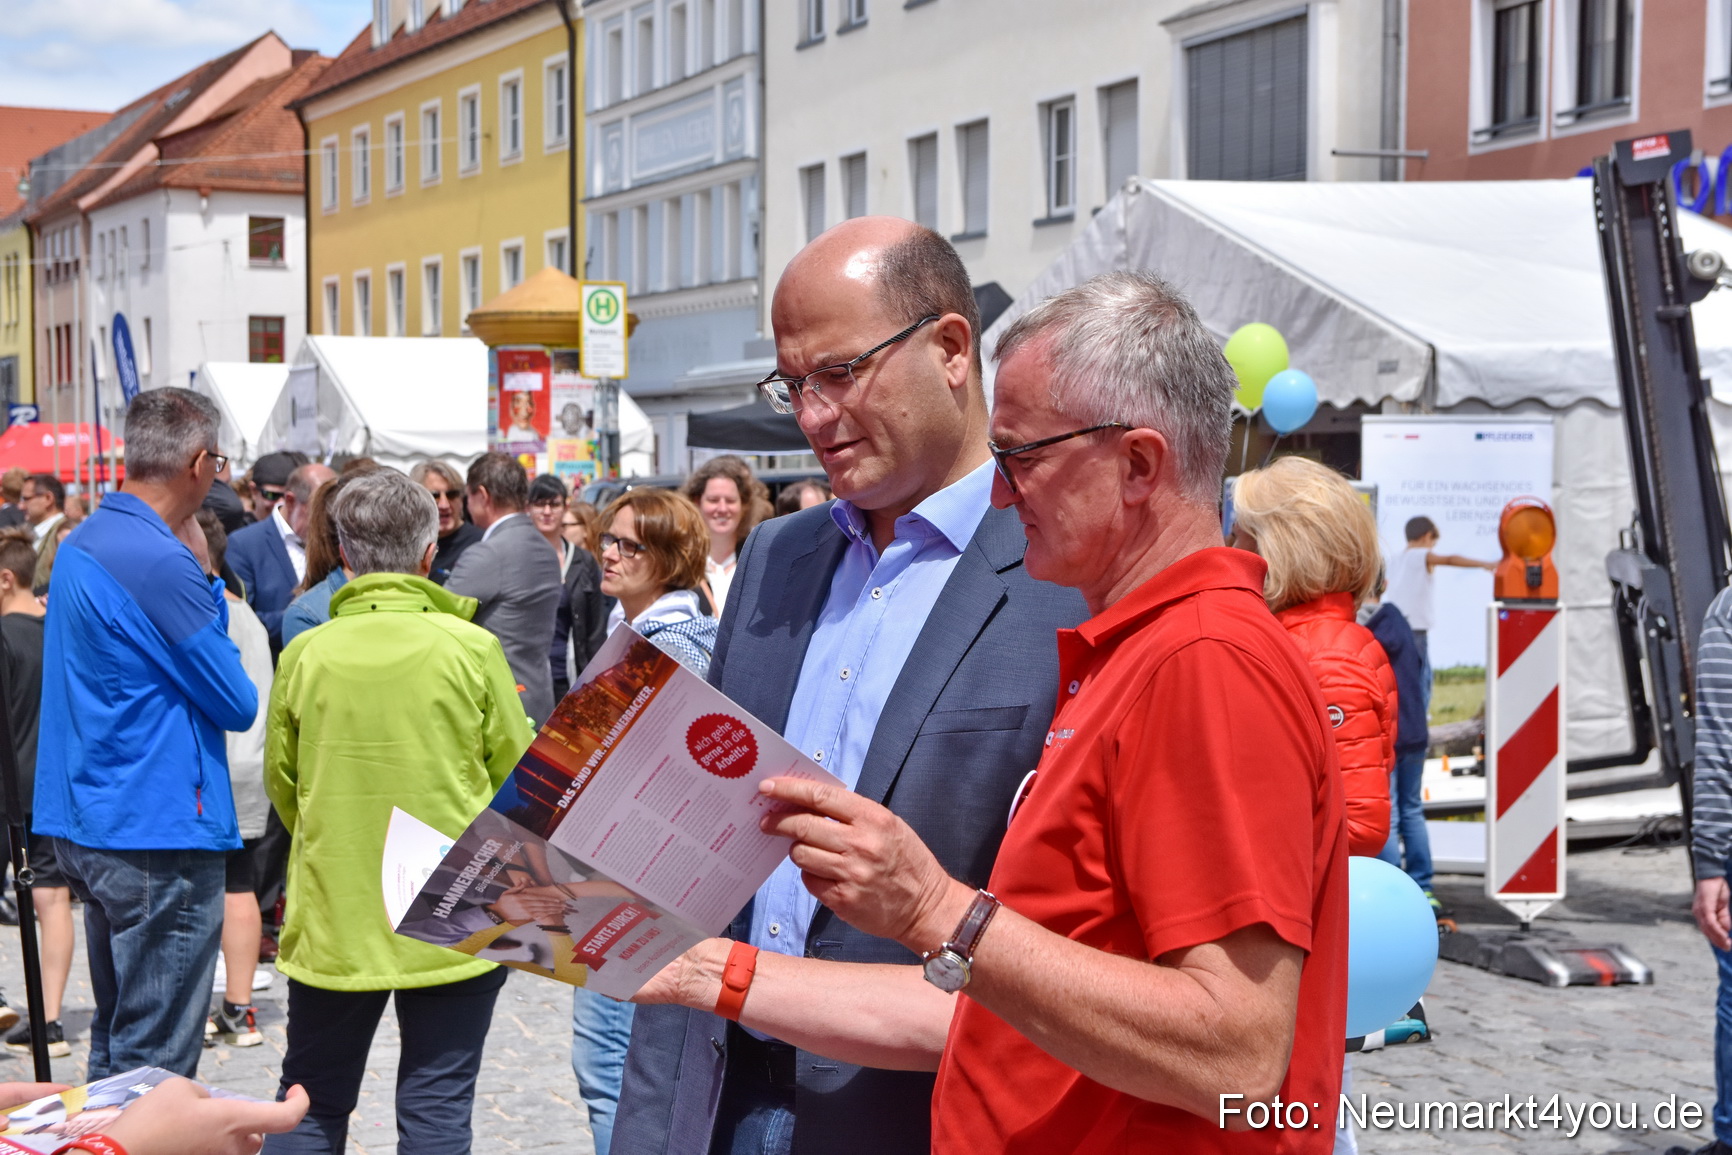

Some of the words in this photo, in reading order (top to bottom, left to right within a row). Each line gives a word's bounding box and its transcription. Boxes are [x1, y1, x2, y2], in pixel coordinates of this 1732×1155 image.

[557, 788, 576, 809] DAS
[571, 765, 592, 791] SIND
[587, 747, 607, 769] WIR.
[601, 685, 655, 748] HAMMERBACHER.
[700, 745, 724, 766] gerne
[722, 741, 733, 750] in
[731, 728, 747, 743] die
[711, 721, 733, 742] gehe
[432, 838, 503, 919] HAMMERBACHER
[474, 874, 492, 893] Büro
[583, 926, 616, 955] STARTE
[608, 906, 641, 936] DURCH!
